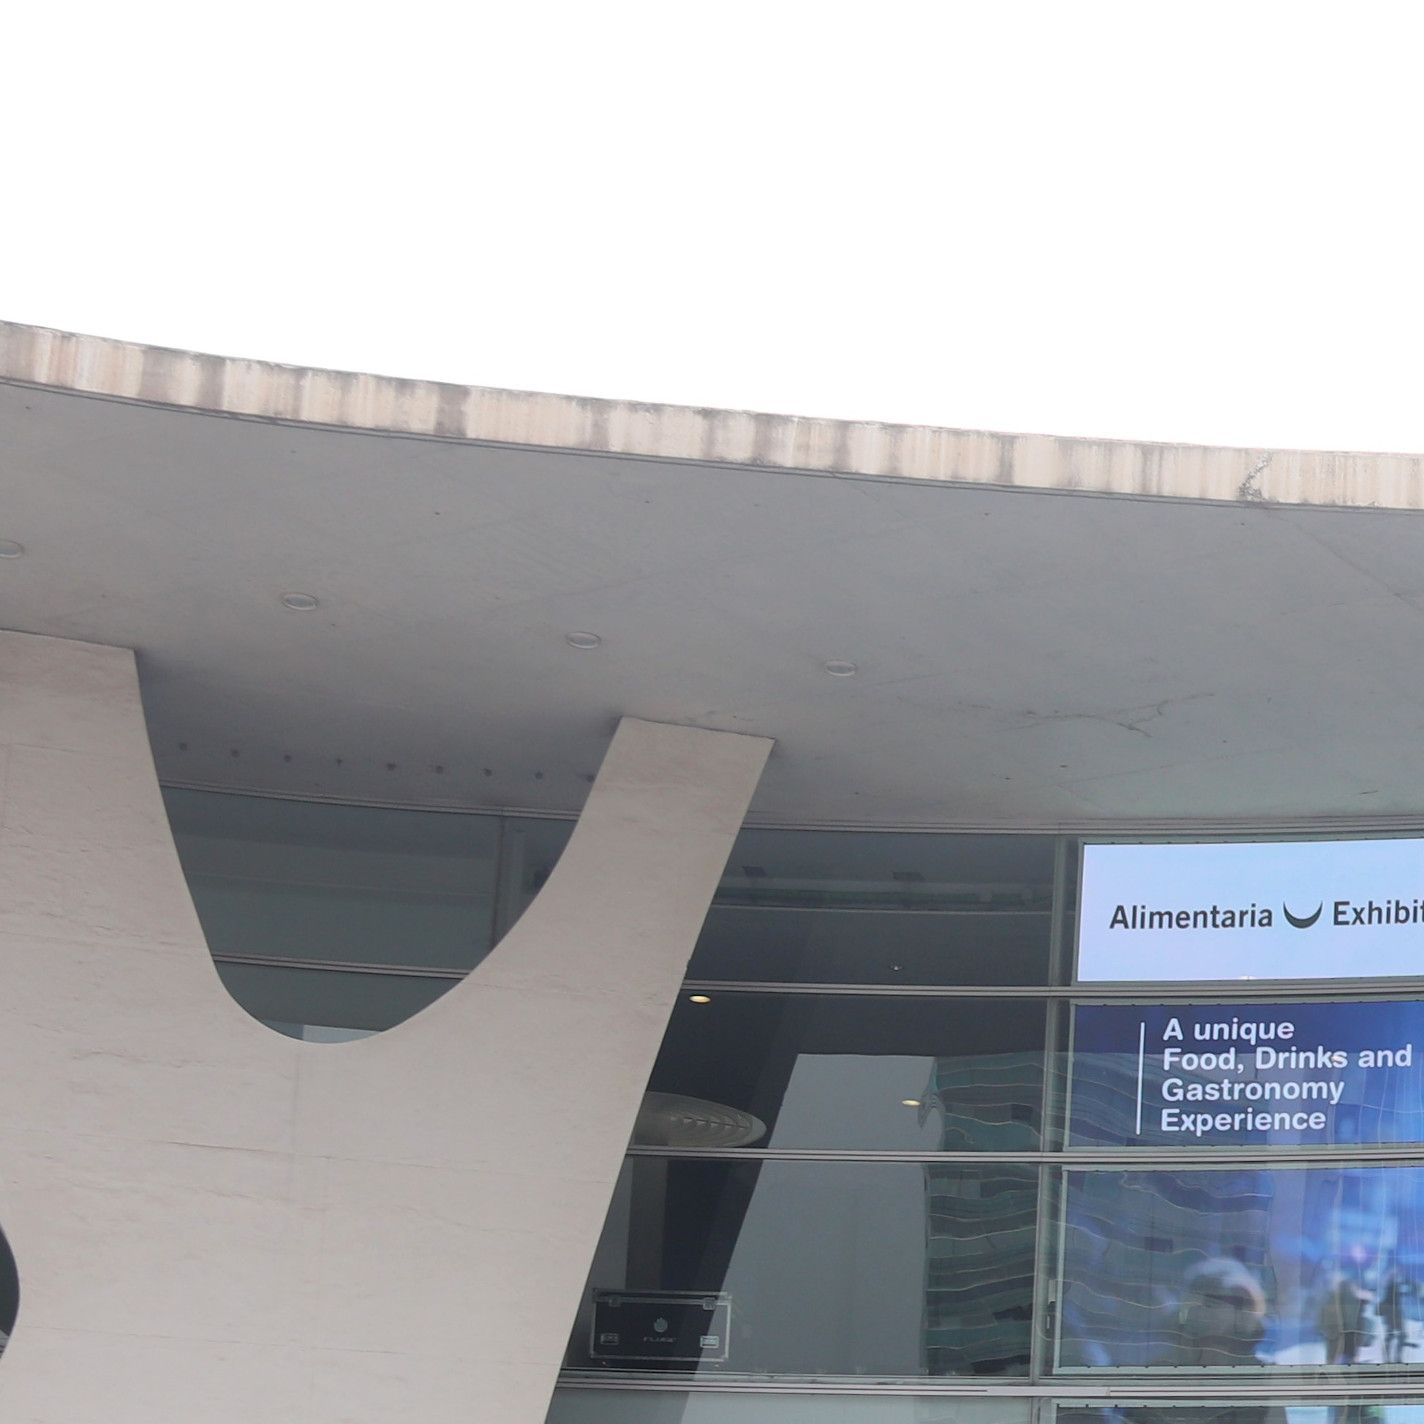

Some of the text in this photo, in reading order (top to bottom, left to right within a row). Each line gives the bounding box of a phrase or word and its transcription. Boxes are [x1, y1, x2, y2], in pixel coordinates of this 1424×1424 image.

[1109, 903, 1273, 930] Alimentaria
[1163, 1018, 1294, 1045] A unique
[1163, 1044, 1412, 1075] Food, Drinks and
[1161, 1078, 1344, 1105] Gastronomy
[1161, 1108, 1326, 1137] Experience
